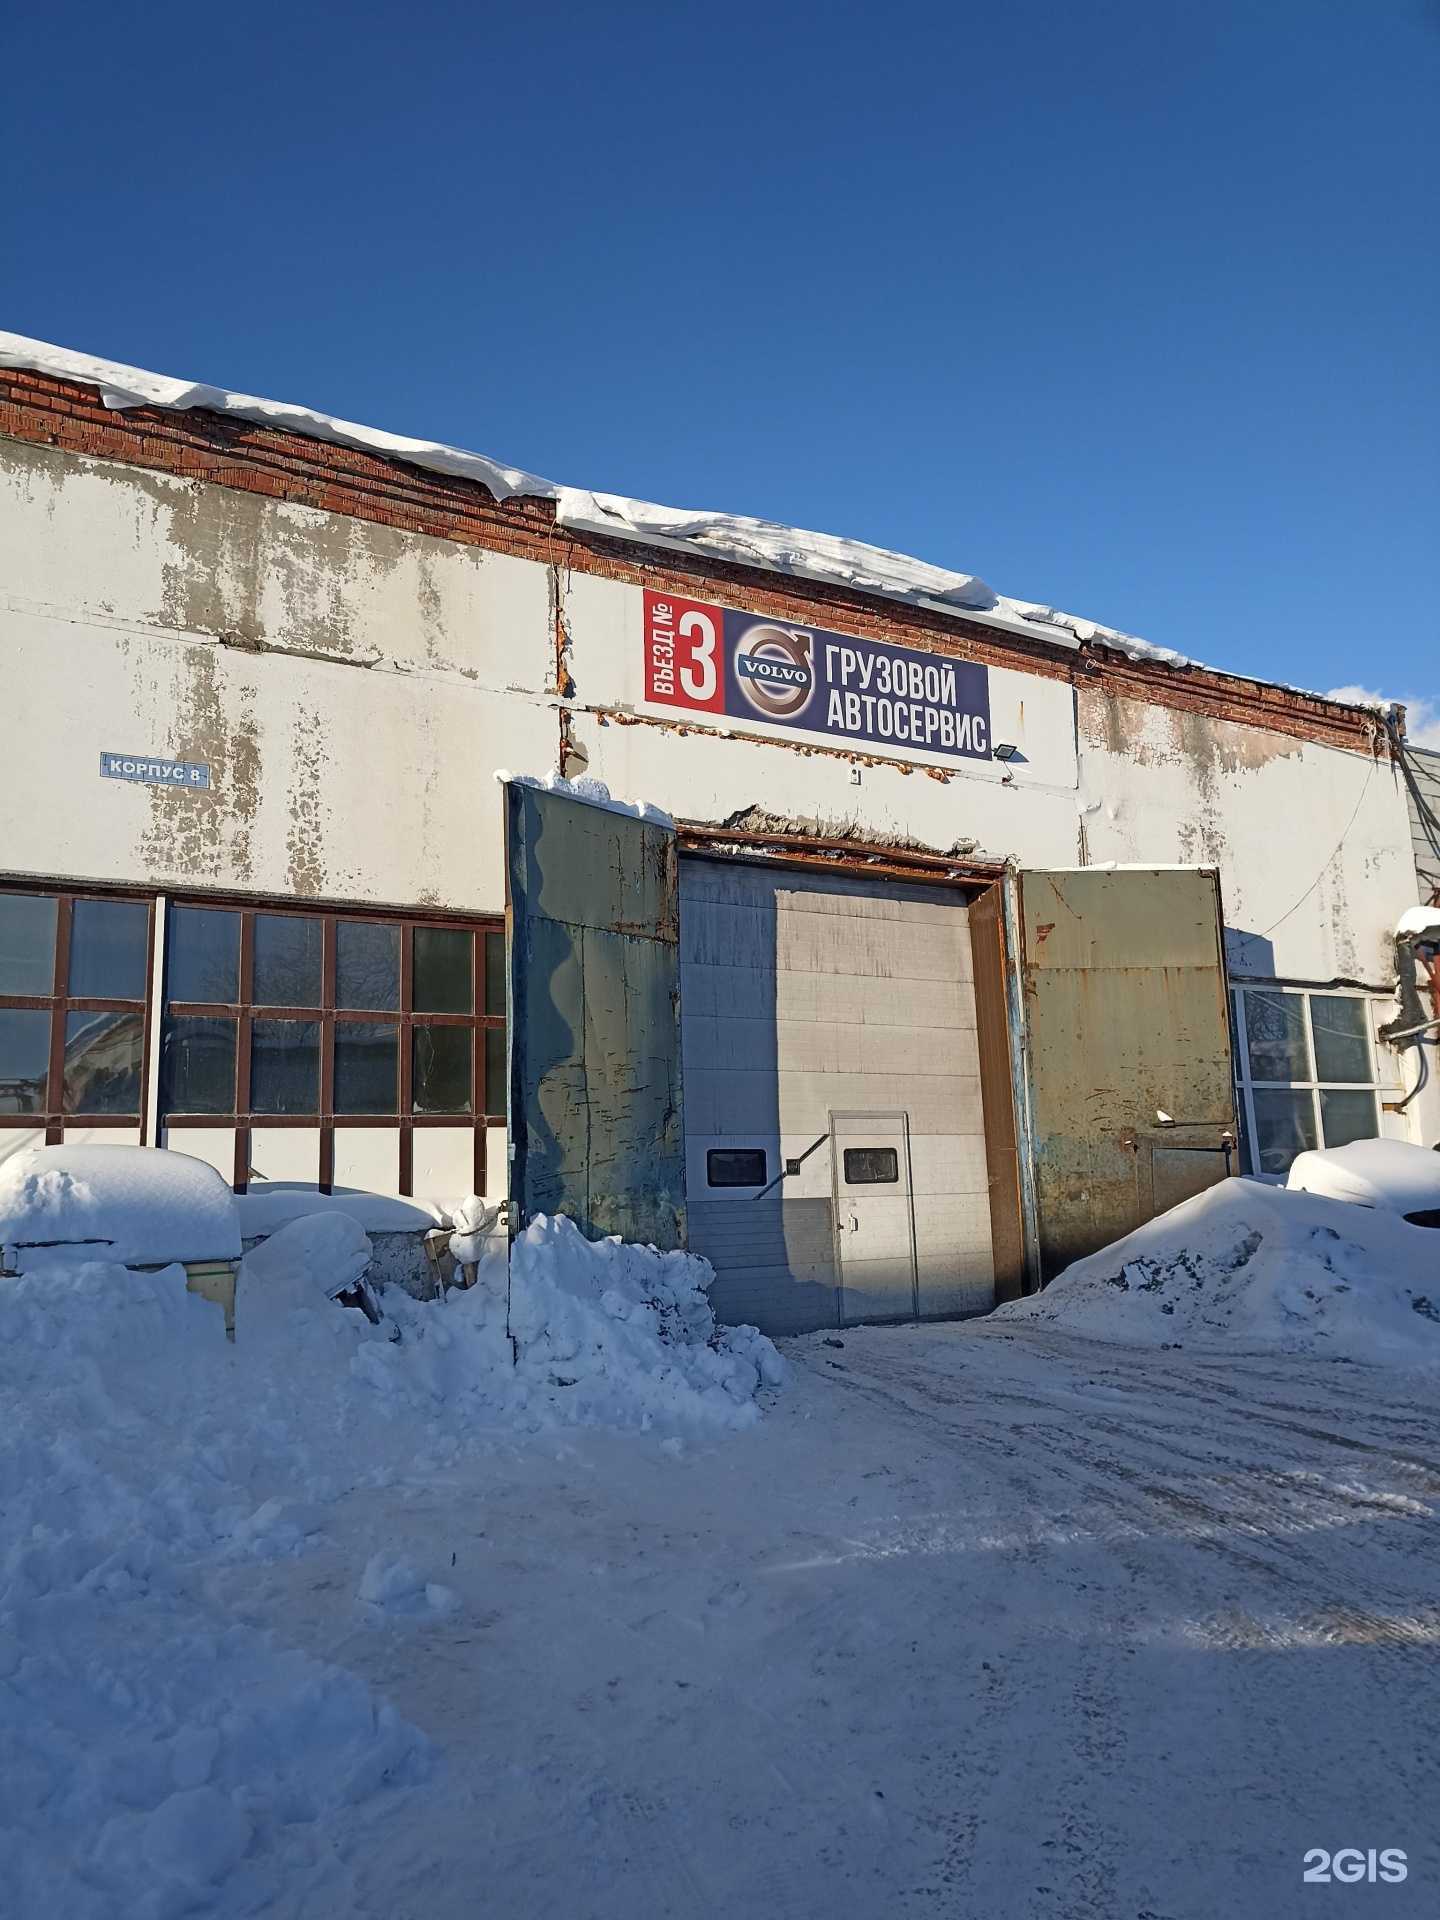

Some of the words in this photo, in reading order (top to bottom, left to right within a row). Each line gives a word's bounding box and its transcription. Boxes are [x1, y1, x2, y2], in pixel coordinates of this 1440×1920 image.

[653, 603, 673, 623] №
[653, 627, 675, 696] ВЪЕЗД
[679, 611, 716, 702] 3
[744, 660, 807, 684] VOLVO
[825, 644, 958, 707] ГРУЗОВОЙ
[827, 689, 987, 754] АВТОСЕРВИС
[110, 760, 184, 779] КОРПУС
